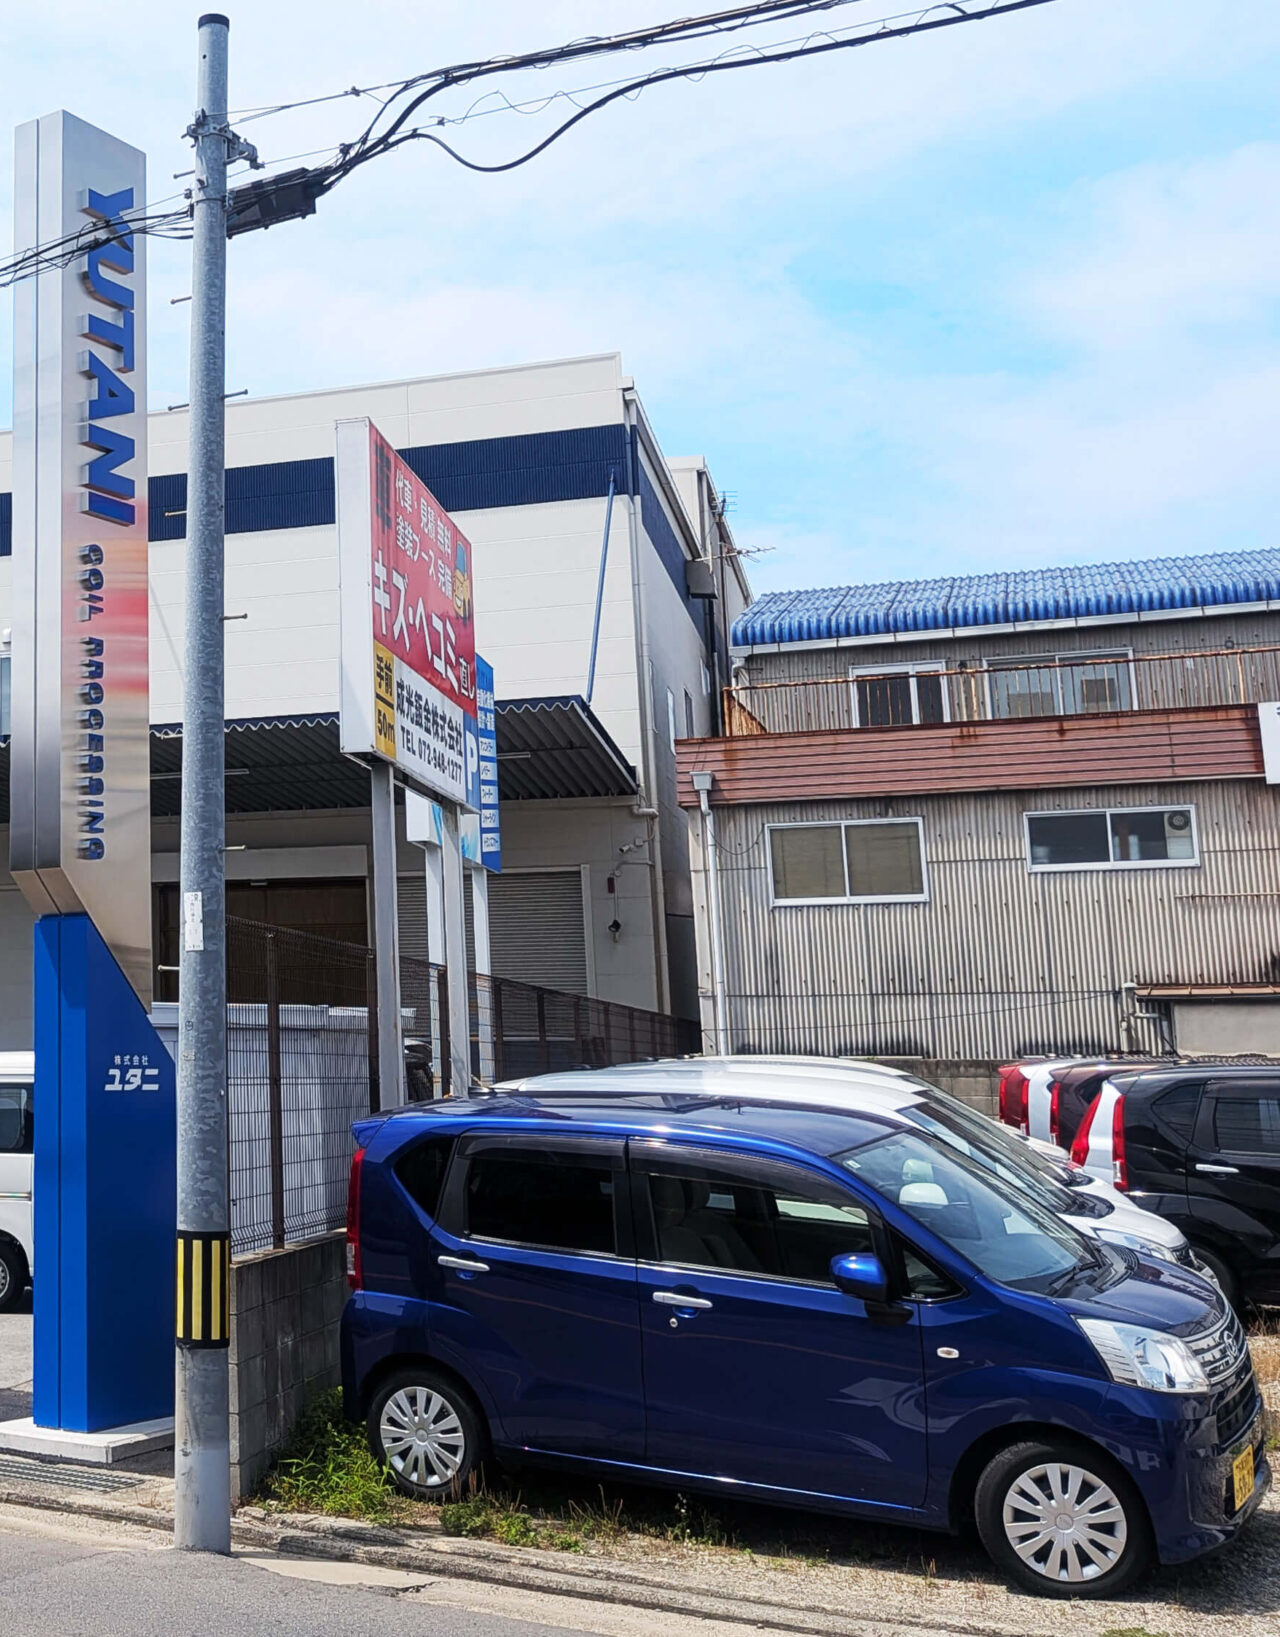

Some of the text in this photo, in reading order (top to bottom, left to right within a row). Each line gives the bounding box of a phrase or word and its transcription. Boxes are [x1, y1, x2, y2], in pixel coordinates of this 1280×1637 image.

[84, 187, 135, 525] YUTANI
[376, 654, 393, 697] 手前
[81, 544, 104, 860] COIL PROCESSING
[377, 708, 395, 745] 50m
[401, 725, 416, 756] TEL
[465, 730, 478, 790] P
[104, 1068, 159, 1091] ユタニ
[114, 1054, 148, 1066] 株式会社
